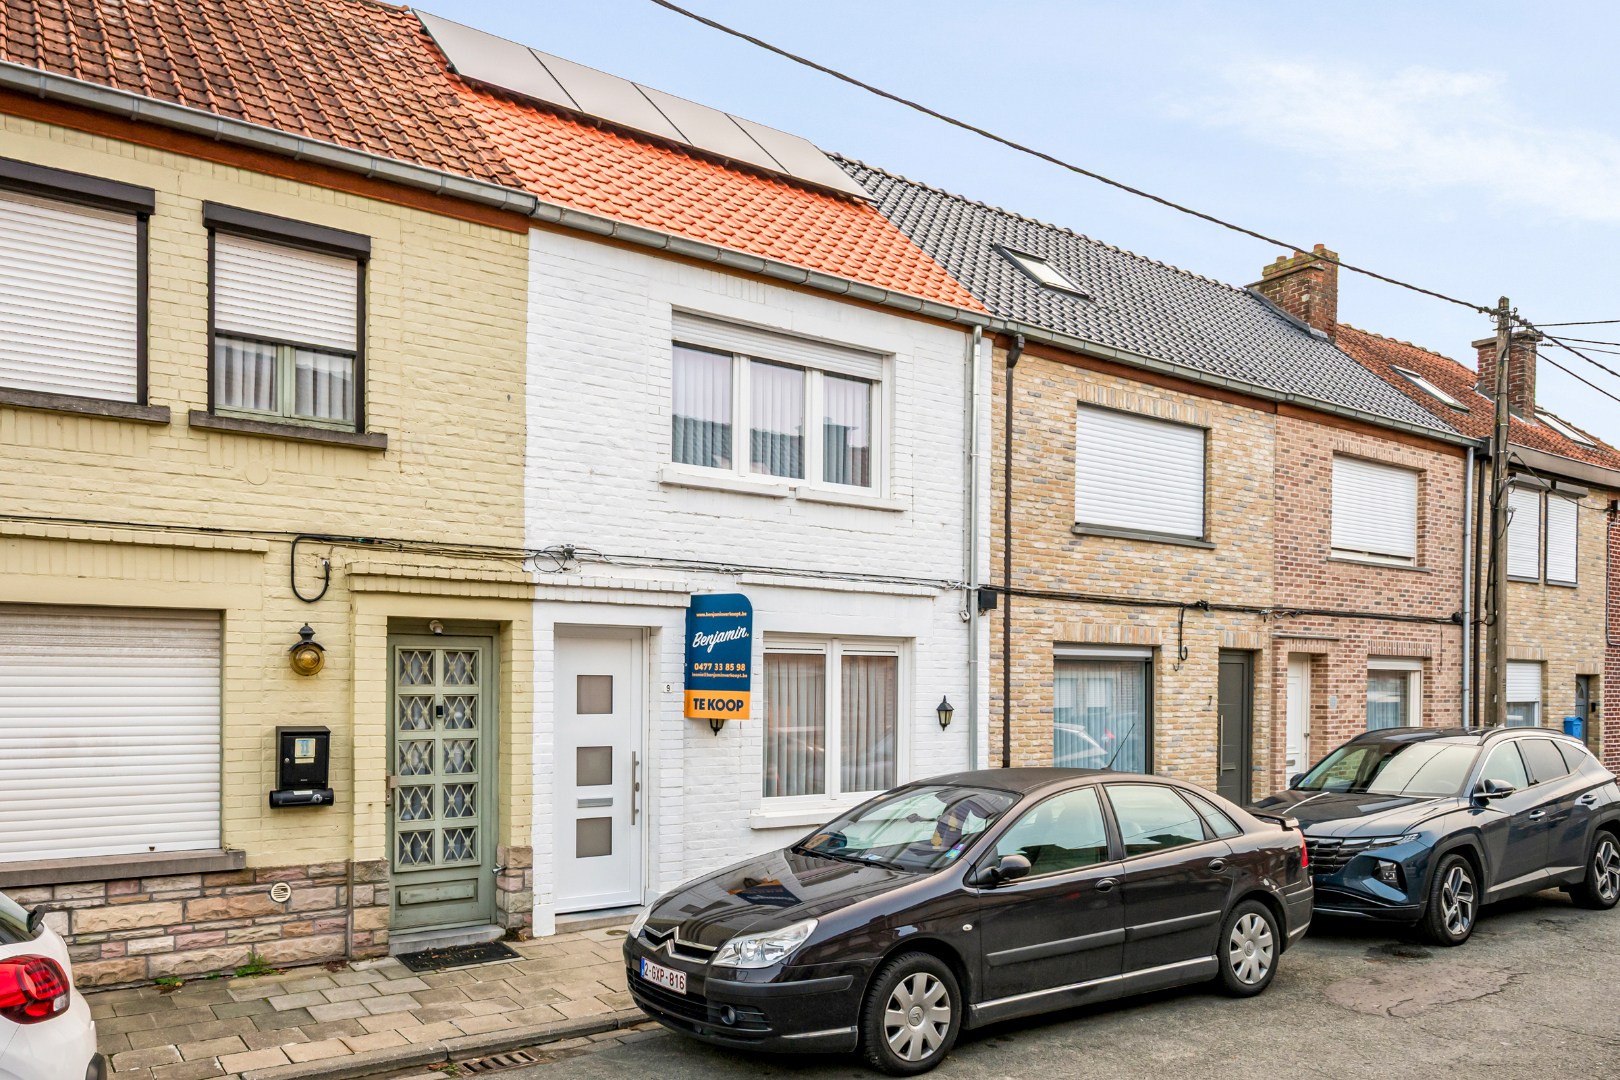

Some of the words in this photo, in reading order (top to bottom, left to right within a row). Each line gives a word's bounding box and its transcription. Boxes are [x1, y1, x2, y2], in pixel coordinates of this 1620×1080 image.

[694, 662, 712, 671] 0477
[714, 663, 723, 671] 33
[725, 664, 734, 672] 85
[736, 664, 746, 672] 98
[693, 698, 706, 710] TE
[708, 698, 744, 712] KOOP
[644, 962, 684, 990] 2-GXP-816
